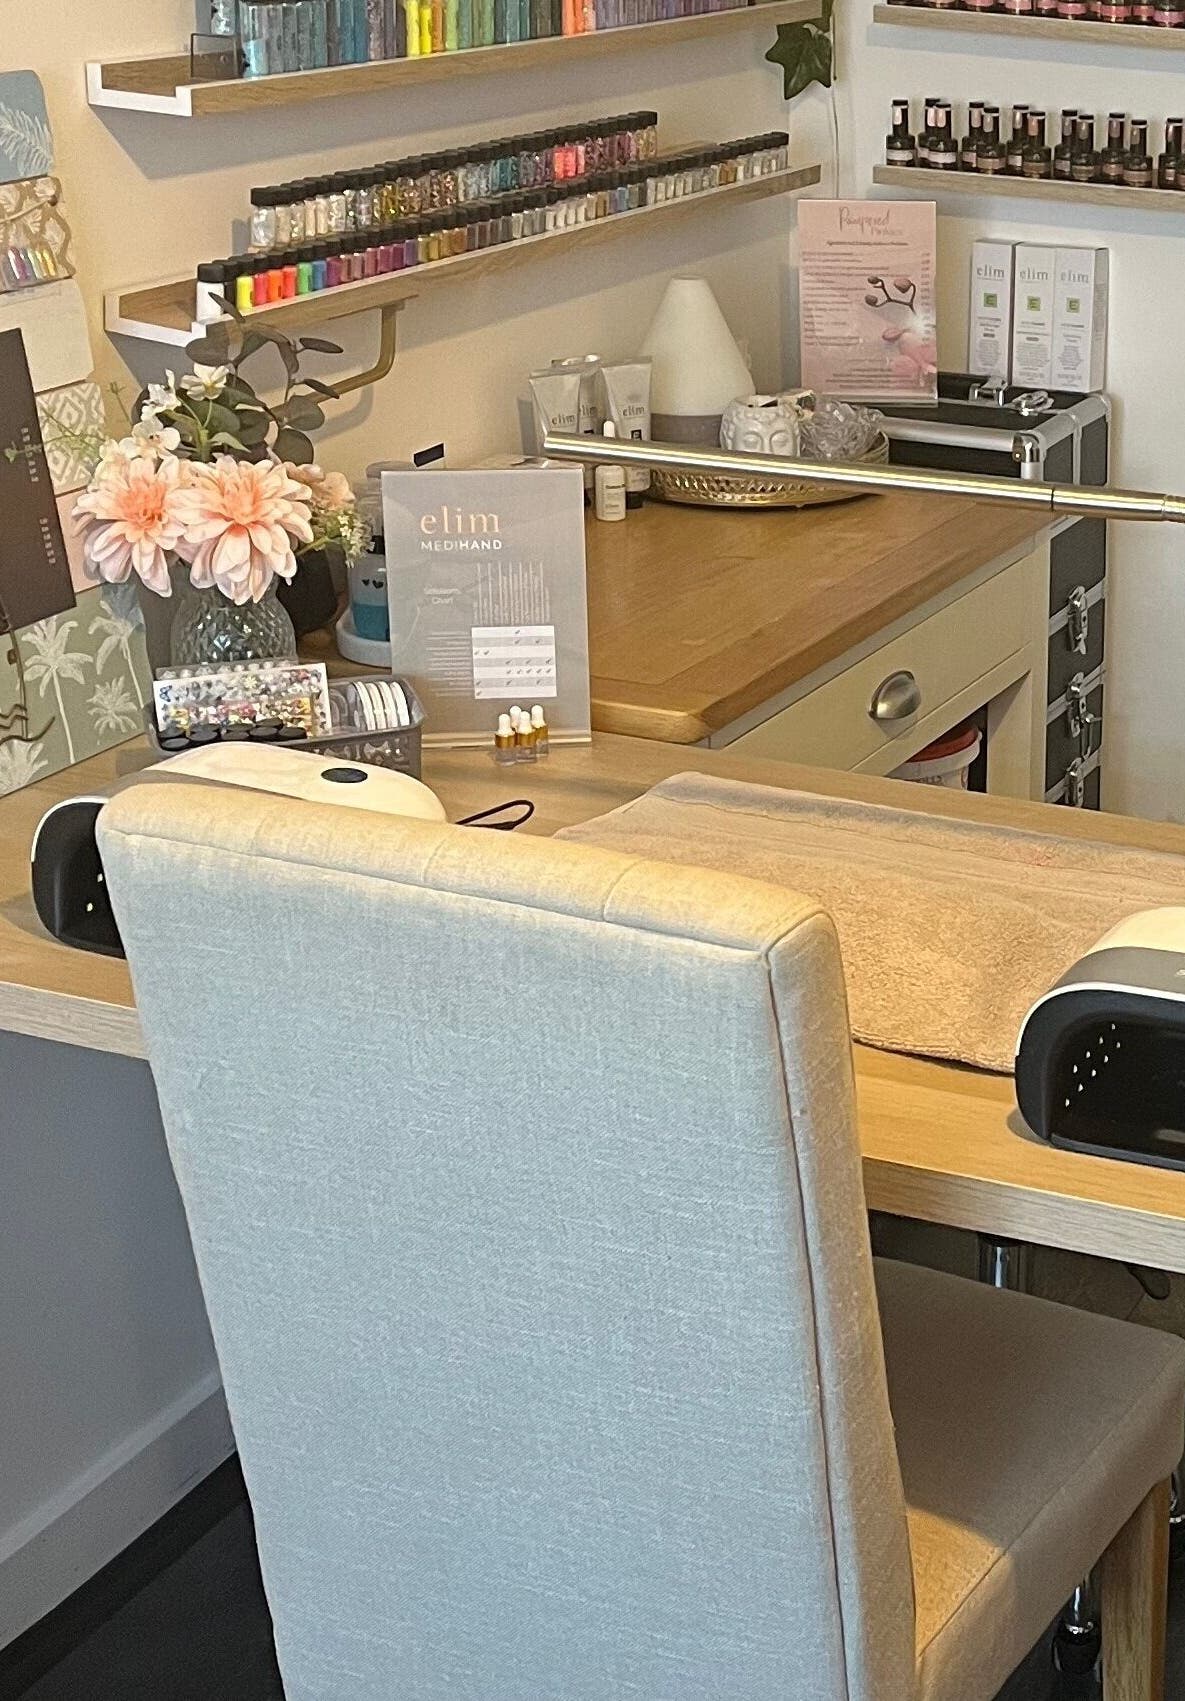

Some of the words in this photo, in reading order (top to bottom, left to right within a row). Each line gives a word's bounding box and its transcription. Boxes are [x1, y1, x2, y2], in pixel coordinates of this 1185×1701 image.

[977, 264, 1005, 279] elim
[1019, 267, 1048, 281] elim
[1061, 269, 1089, 283] elim
[622, 405, 645, 417] elim
[551, 413, 576, 425] elim
[420, 505, 501, 536] elim
[420, 539, 503, 551] MEDIHAND
